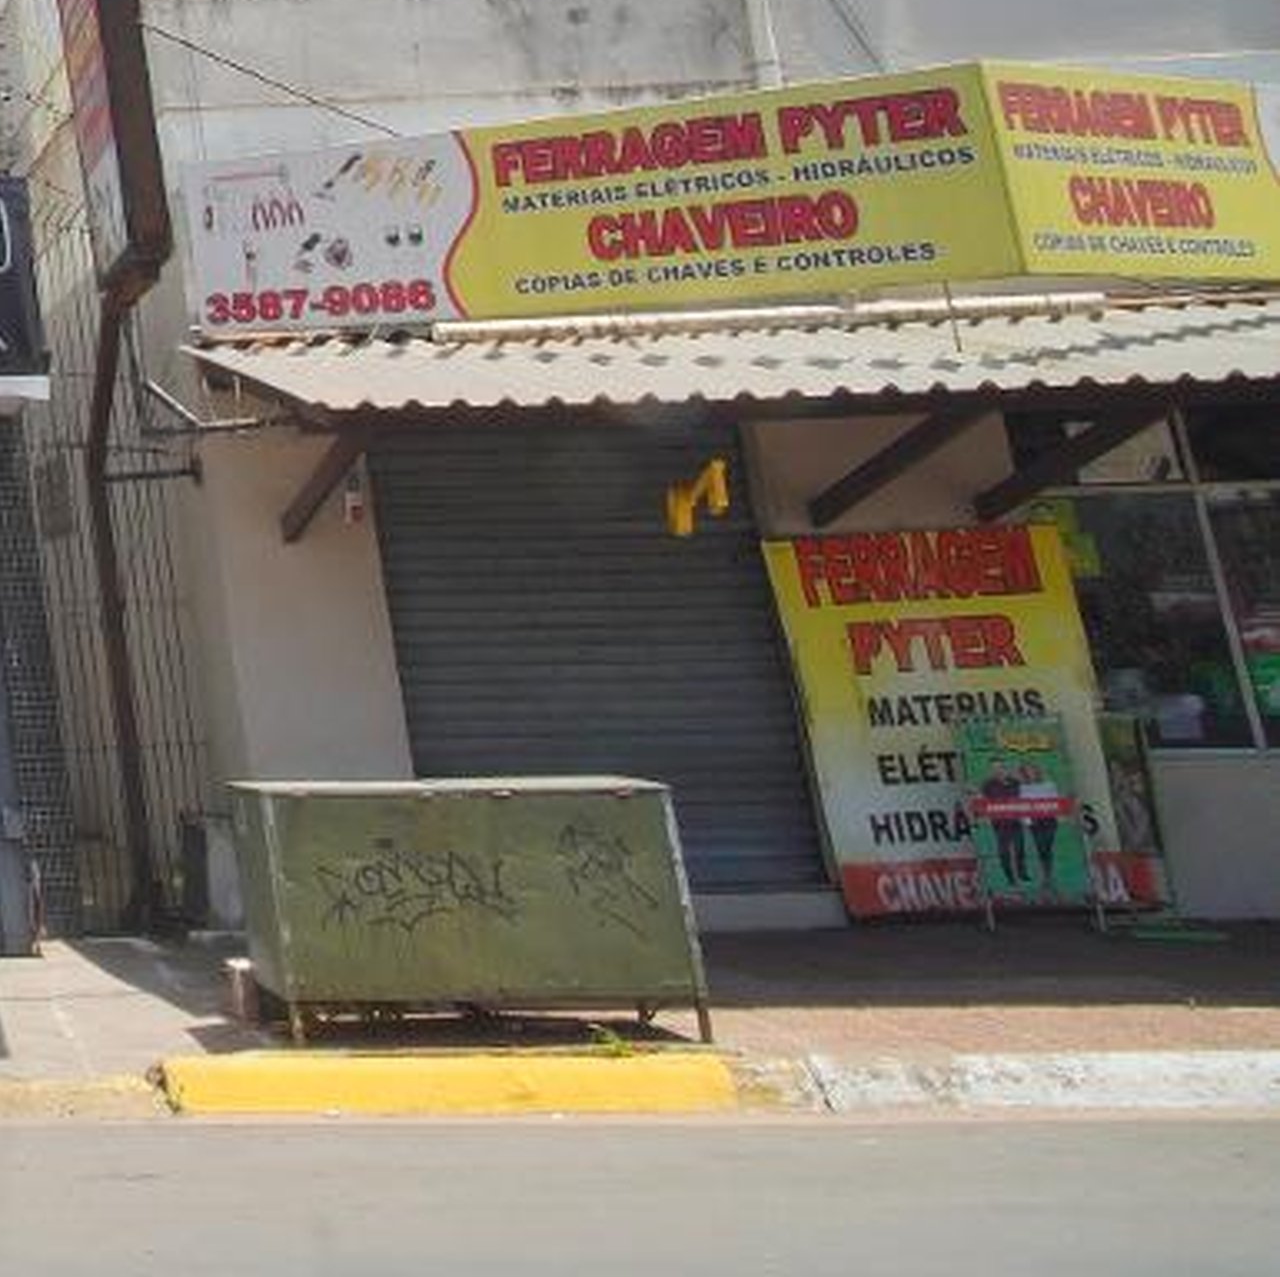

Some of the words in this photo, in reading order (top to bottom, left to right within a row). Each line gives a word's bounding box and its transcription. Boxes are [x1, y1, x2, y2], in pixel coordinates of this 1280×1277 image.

[492, 112, 768, 186] FERRAGEM
[778, 87, 968, 155] PYTER
[997, 80, 1157, 141] FERRAGEM
[1155, 95, 1252, 148] PYTER
[502, 185, 628, 214] MATERIAIS
[587, 189, 860, 261] CHAVEIRO
[1068, 174, 1216, 229] CHAVEIRO
[609, 268, 639, 288] DE
[647, 258, 745, 284] CHAVES
[754, 256, 768, 274] E
[777, 242, 936, 272] CONTROLES
[794, 523, 1045, 608] FERRAGEM
[845, 614, 1027, 675] PYTER
[868, 688, 1045, 727] MATERIAIS
[877, 743, 967, 786] ELÉT
